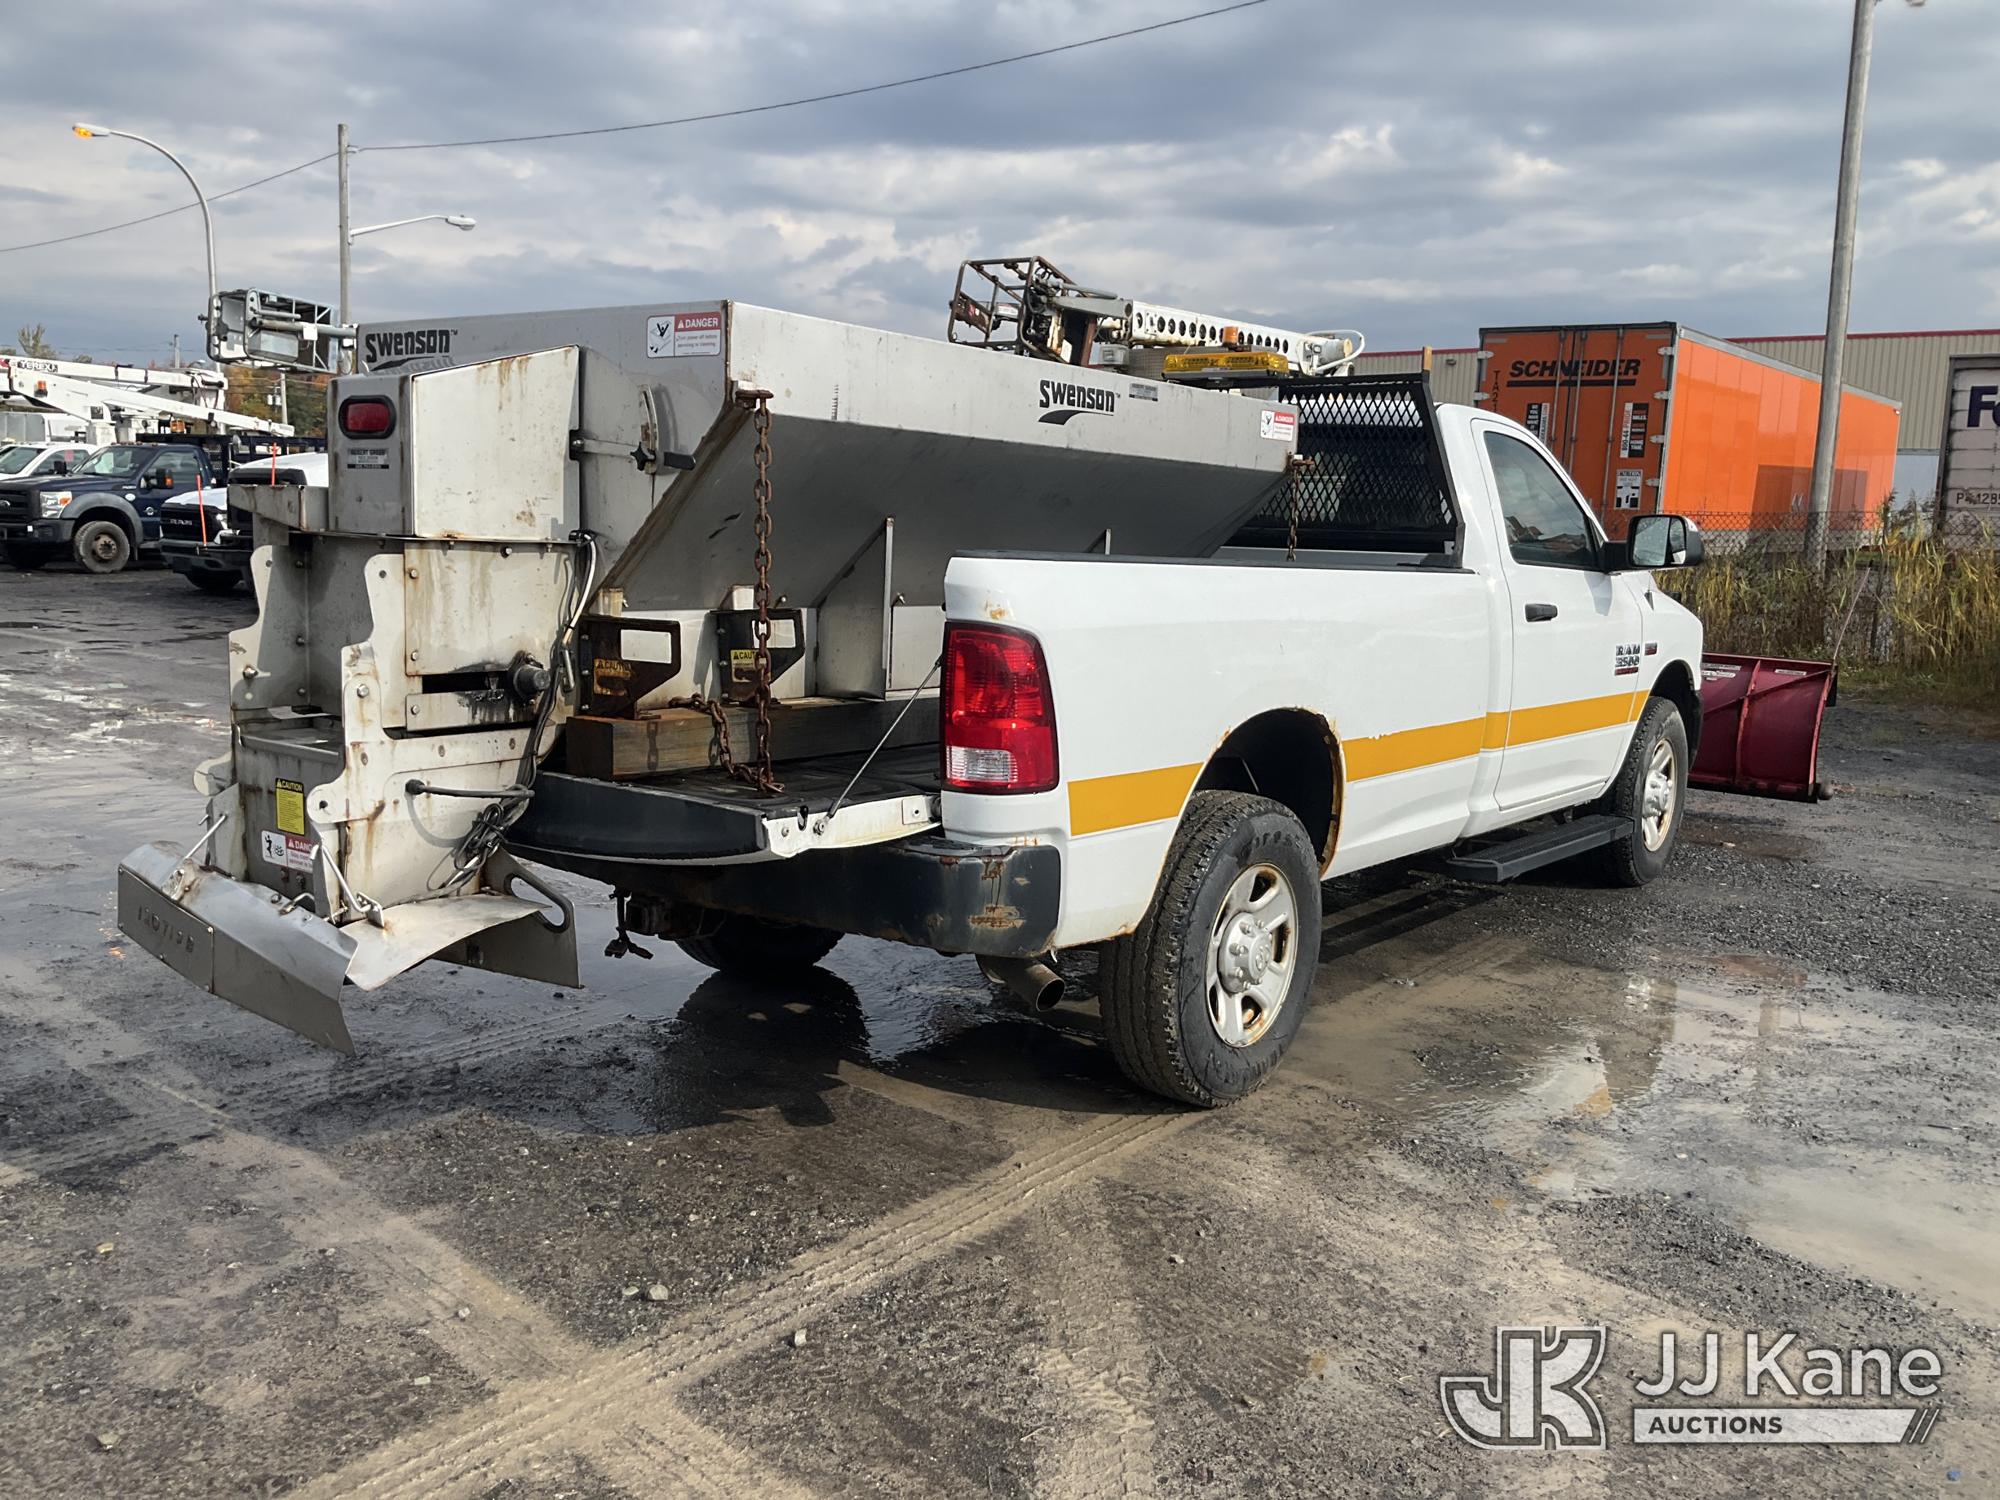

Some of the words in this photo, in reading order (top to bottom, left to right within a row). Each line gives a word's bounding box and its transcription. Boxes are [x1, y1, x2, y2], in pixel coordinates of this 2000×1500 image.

[685, 318, 718, 328] DANGER
[365, 329, 450, 363] Swenson
[1509, 358, 1641, 378] SCHNEIDER
[1040, 379, 1115, 413] Swenson
[1615, 644, 1640, 656] RAM
[281, 780, 303, 792] CAUTION
